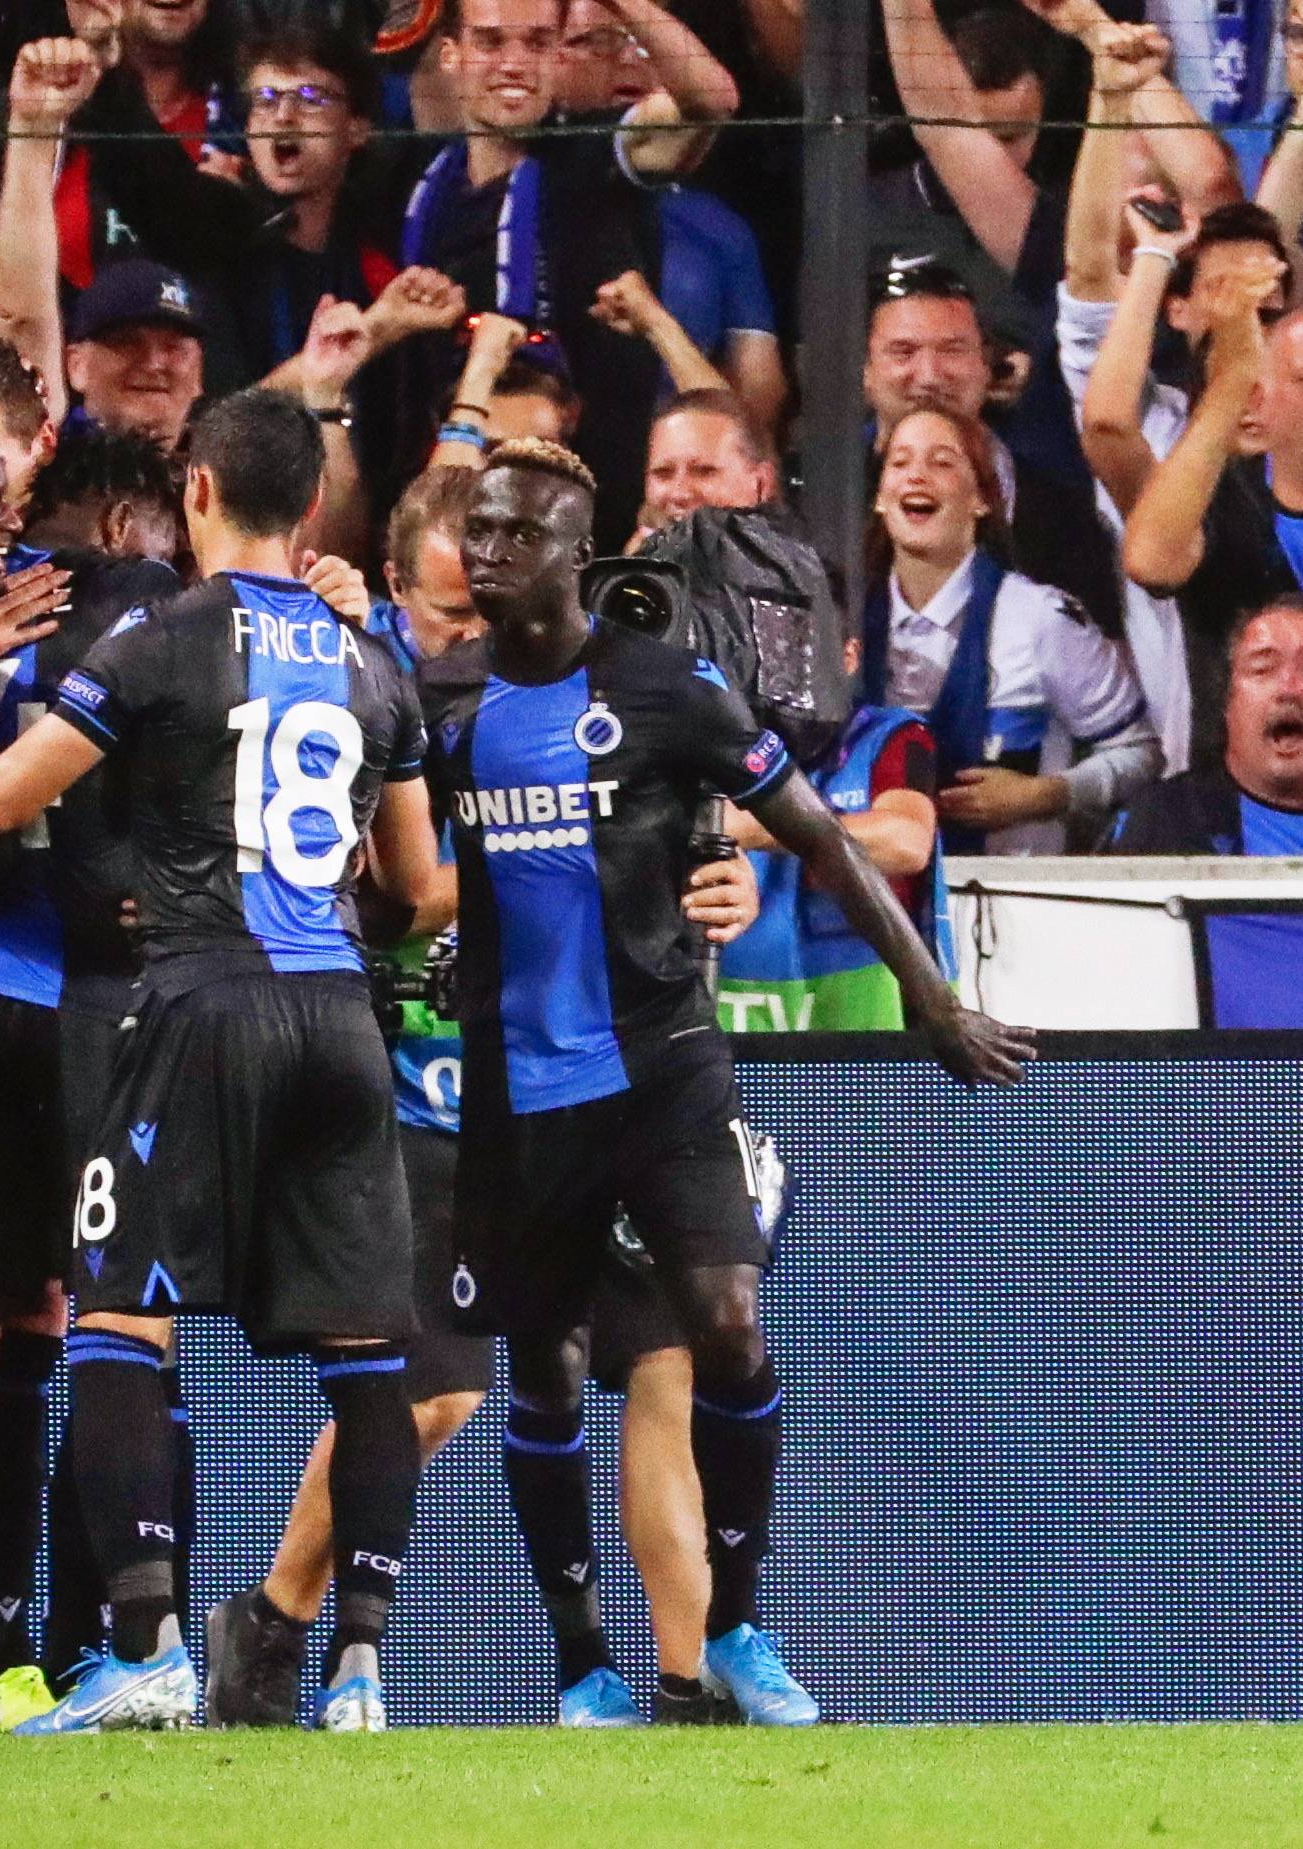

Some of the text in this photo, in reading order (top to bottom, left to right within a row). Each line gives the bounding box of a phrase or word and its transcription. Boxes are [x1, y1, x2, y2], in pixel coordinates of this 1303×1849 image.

[232, 607, 365, 669] F.RICCA
[63, 676, 105, 705] RESPECT
[227, 696, 364, 887] 18
[454, 780, 619, 827] UNIBET
[717, 990, 816, 1033] TV
[353, 1550, 402, 1577] FCB
